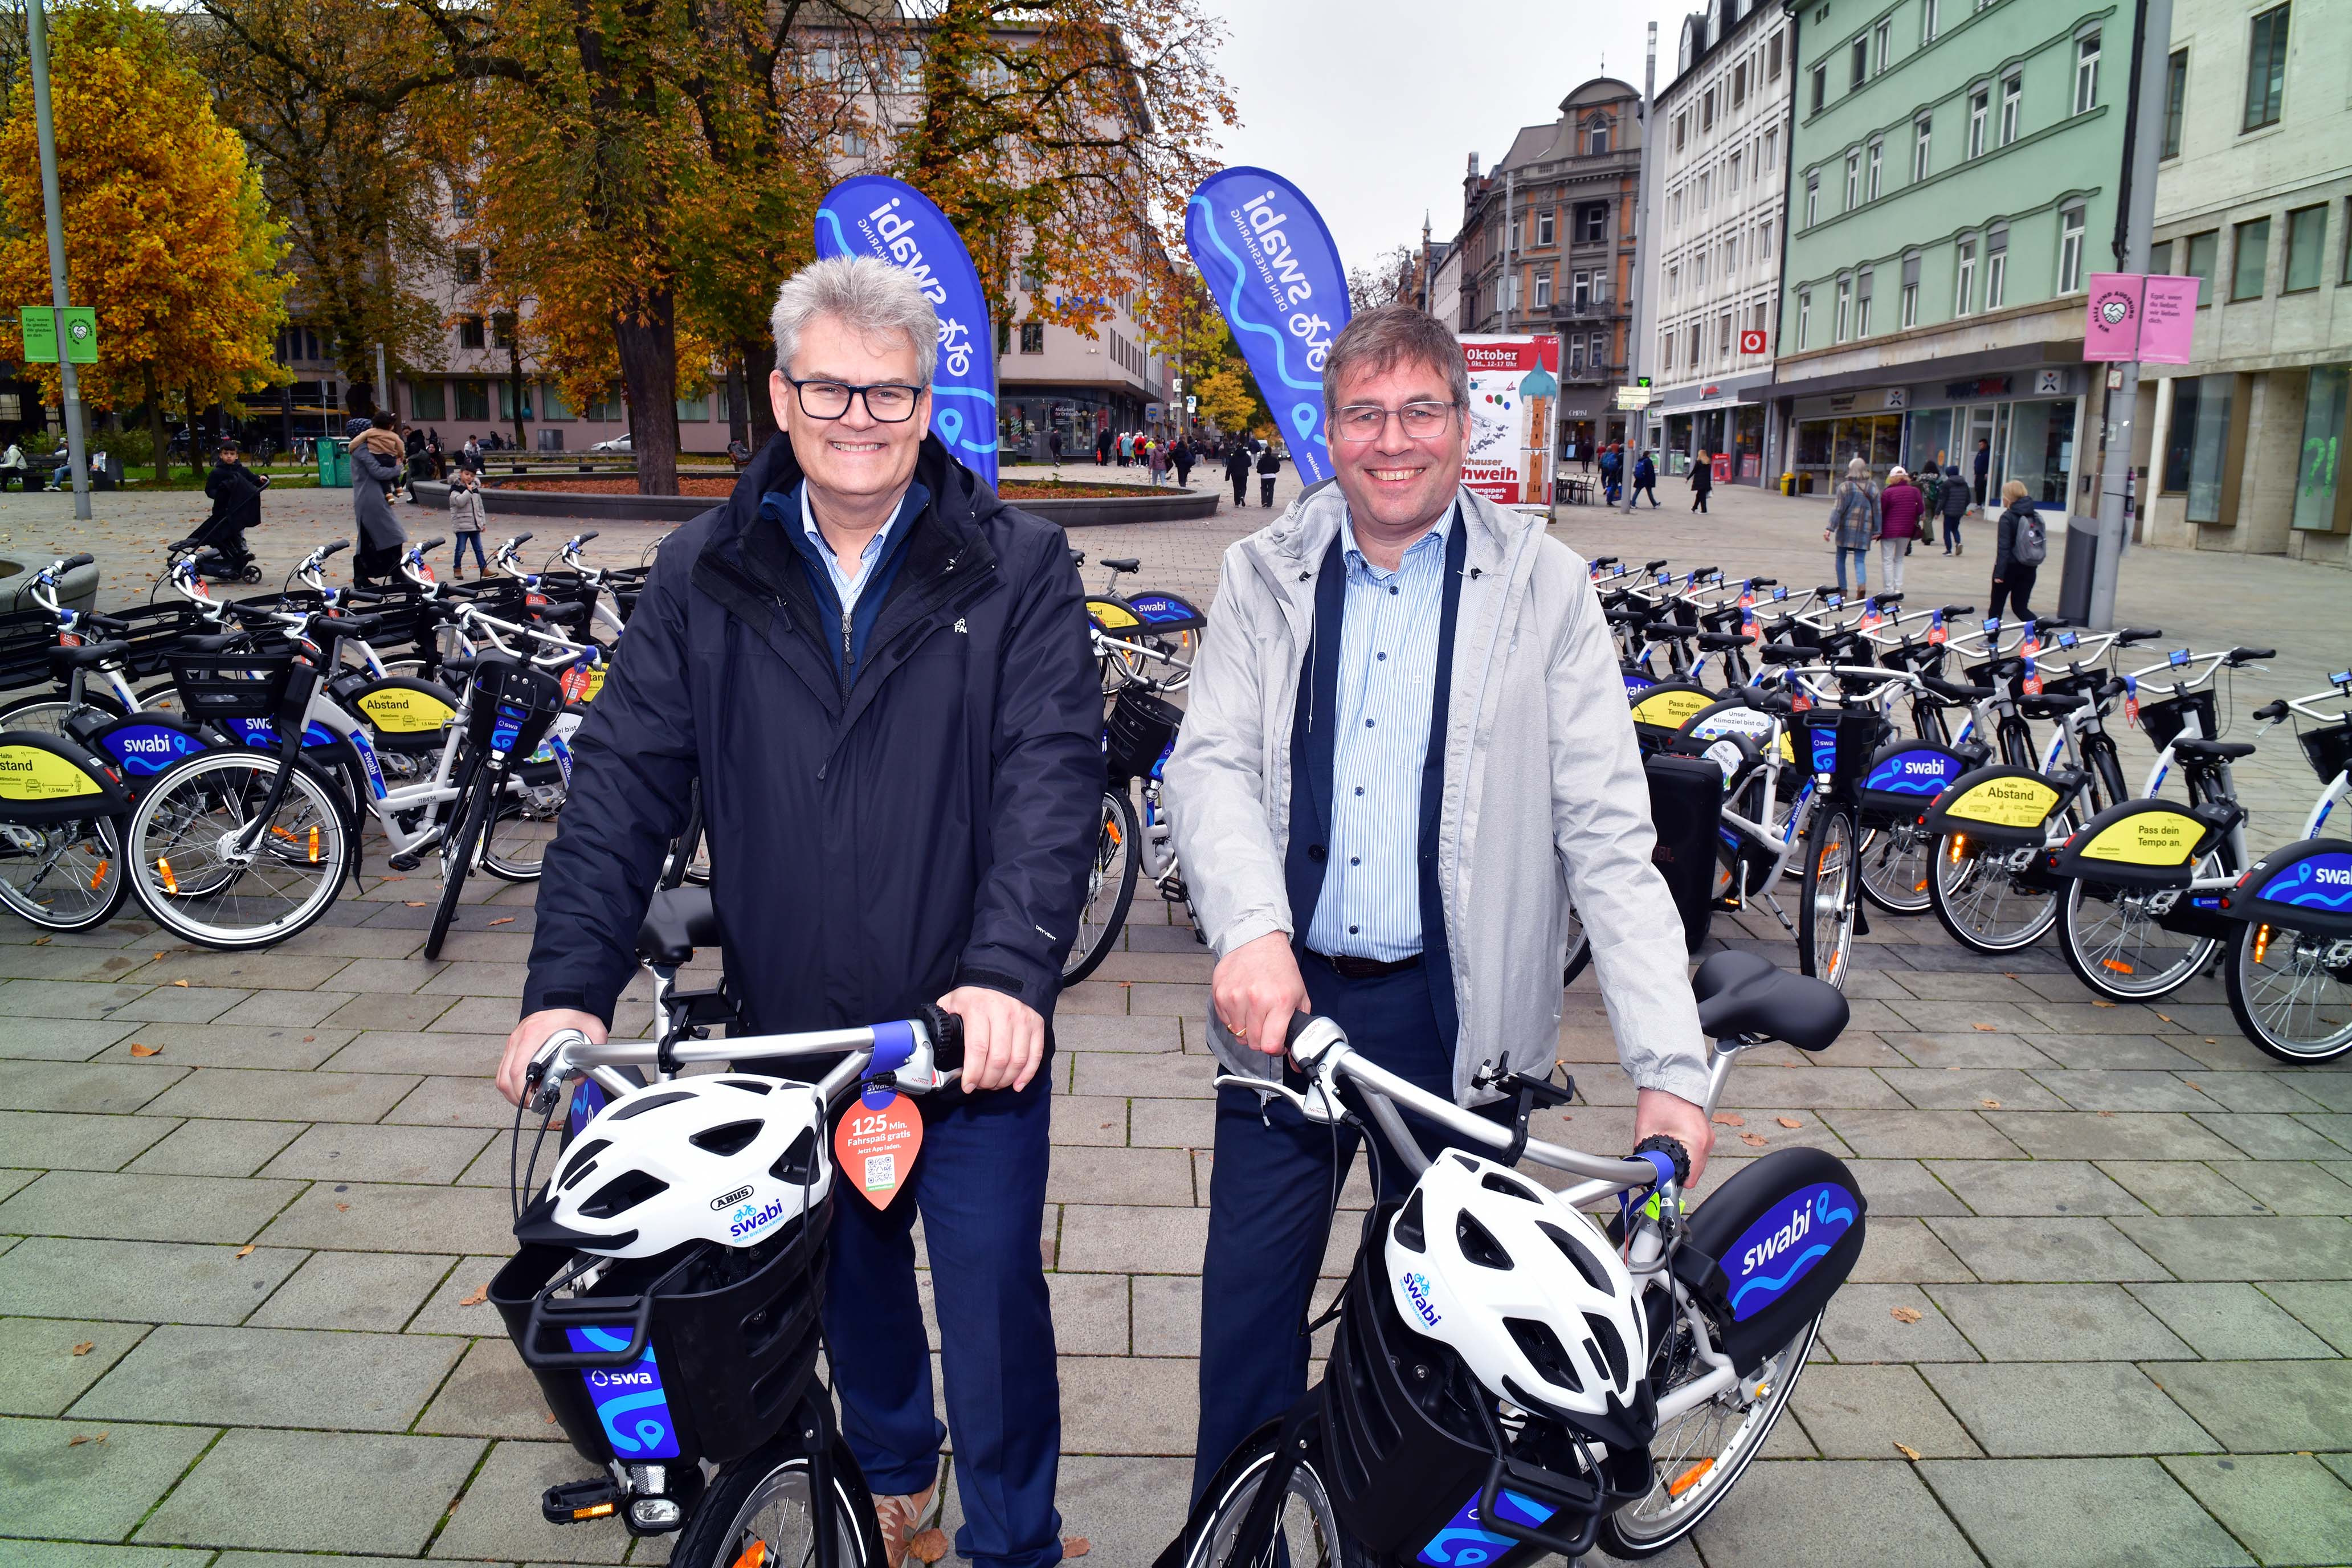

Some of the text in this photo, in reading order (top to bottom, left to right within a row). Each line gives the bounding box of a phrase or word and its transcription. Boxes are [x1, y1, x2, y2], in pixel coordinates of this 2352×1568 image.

[2097, 292, 2113, 305] SIND
[2114, 291, 2135, 319] AUGSBURG
[2098, 324, 2109, 333] WIR
[1467, 349, 1517, 361] Oktober
[1465, 458, 1502, 466] hauser
[1461, 466, 1518, 481] hweih
[1139, 601, 1166, 611] swabi
[367, 700, 410, 709] Abstand
[1668, 708, 1690, 717] Tempo
[123, 734, 170, 753] swabi
[0, 760, 33, 771] stand
[364, 751, 379, 775] swabi
[1905, 759, 1945, 775] swabi
[417, 795, 437, 805] 118434
[1987, 787, 2034, 801] Abstand
[1791, 799, 1804, 823] swabi
[2138, 826, 2179, 835] Pass dein
[2138, 838, 2167, 848] Tempo
[2316, 865, 2352, 885] swa
[1035, 925, 1056, 941] DRYVENT
[852, 1114, 908, 1137] 125 Min.
[847, 1130, 910, 1147] Fahrspaß gratis
[857, 1142, 901, 1155] Jetzt App laden.
[717, 1189, 749, 1208] ABUS
[730, 1198, 783, 1237] swabi
[734, 1214, 785, 1244] DEIN BIKESHARING
[1741, 1199, 1811, 1276] swabi
[1403, 1272, 1442, 1326] swabi
[1405, 1293, 1429, 1330] BIKESHARING
[610, 1372, 652, 1385] swa
